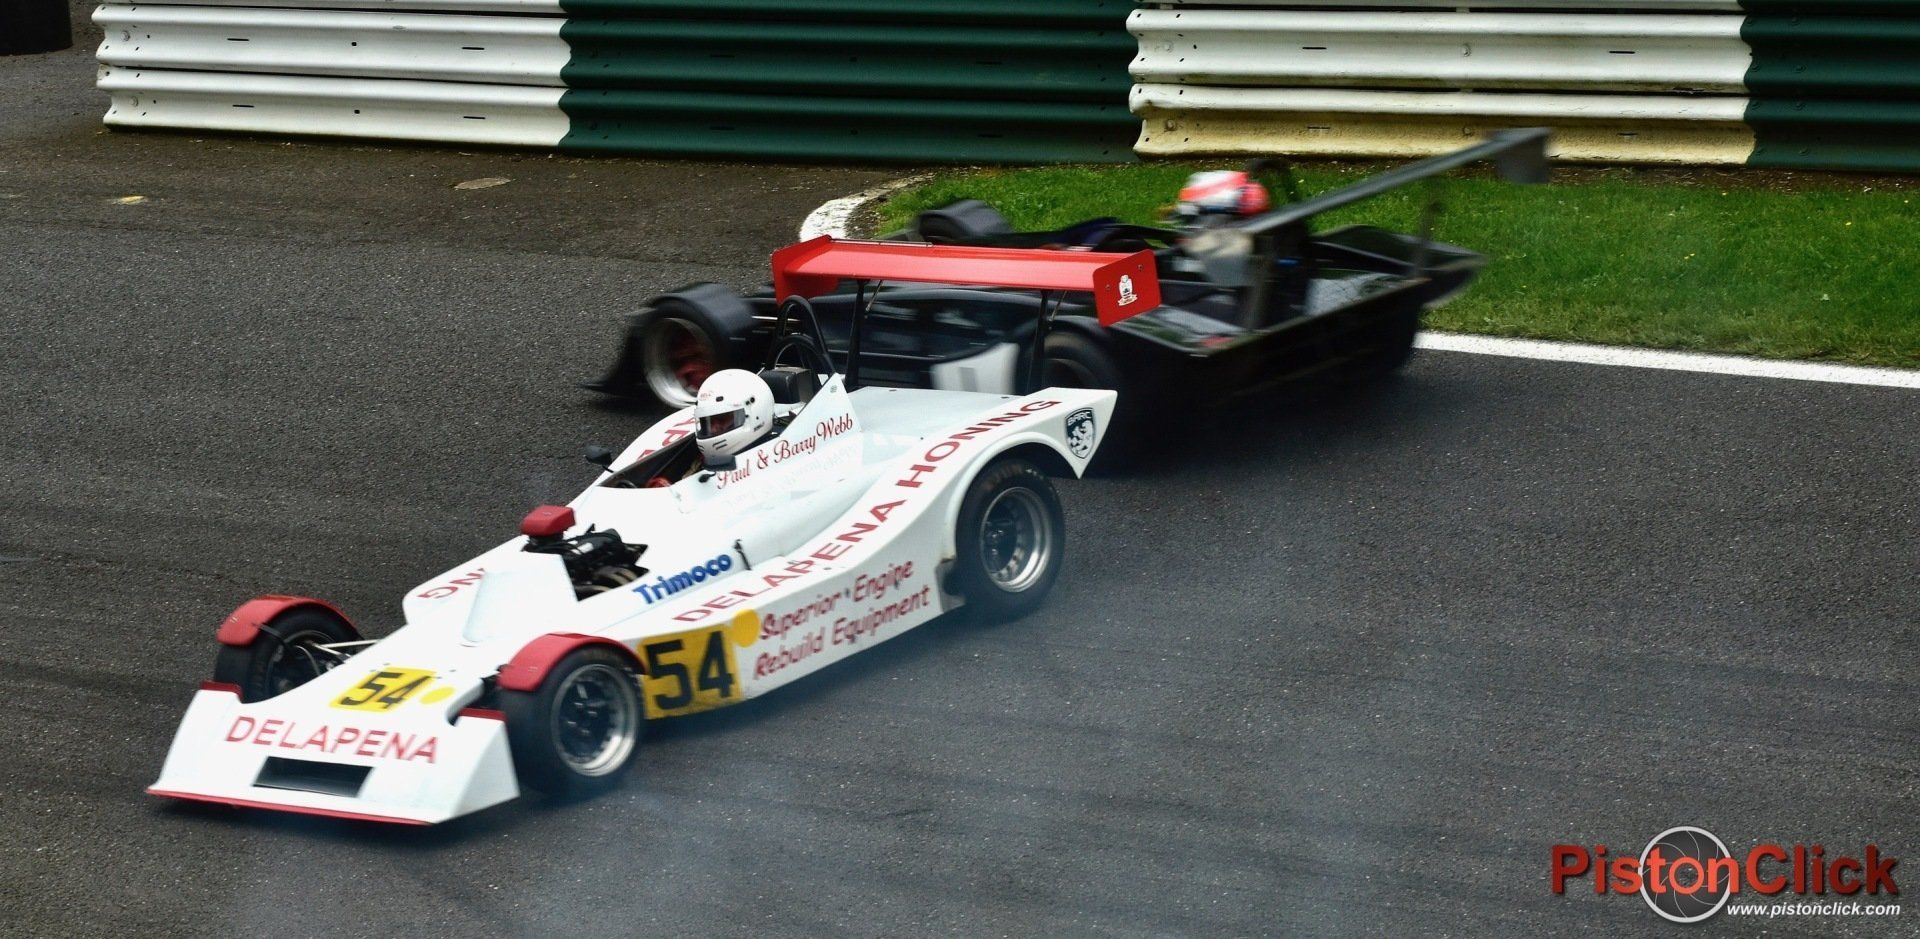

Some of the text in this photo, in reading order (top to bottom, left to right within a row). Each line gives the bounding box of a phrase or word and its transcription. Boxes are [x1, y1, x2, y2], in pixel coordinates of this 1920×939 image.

[757, 449, 769, 470] &
[774, 435, 817, 464] Barry
[816, 413, 853, 442] Webb
[672, 499, 907, 622] DELAPENA
[895, 400, 1063, 489] HONING
[633, 553, 732, 605] Trimoco
[759, 560, 914, 641] Superior Engine
[753, 584, 931, 681] Rebuild Equipment
[340, 671, 432, 710] 54
[644, 630, 735, 710] 54
[224, 715, 439, 764] DELAPENA
